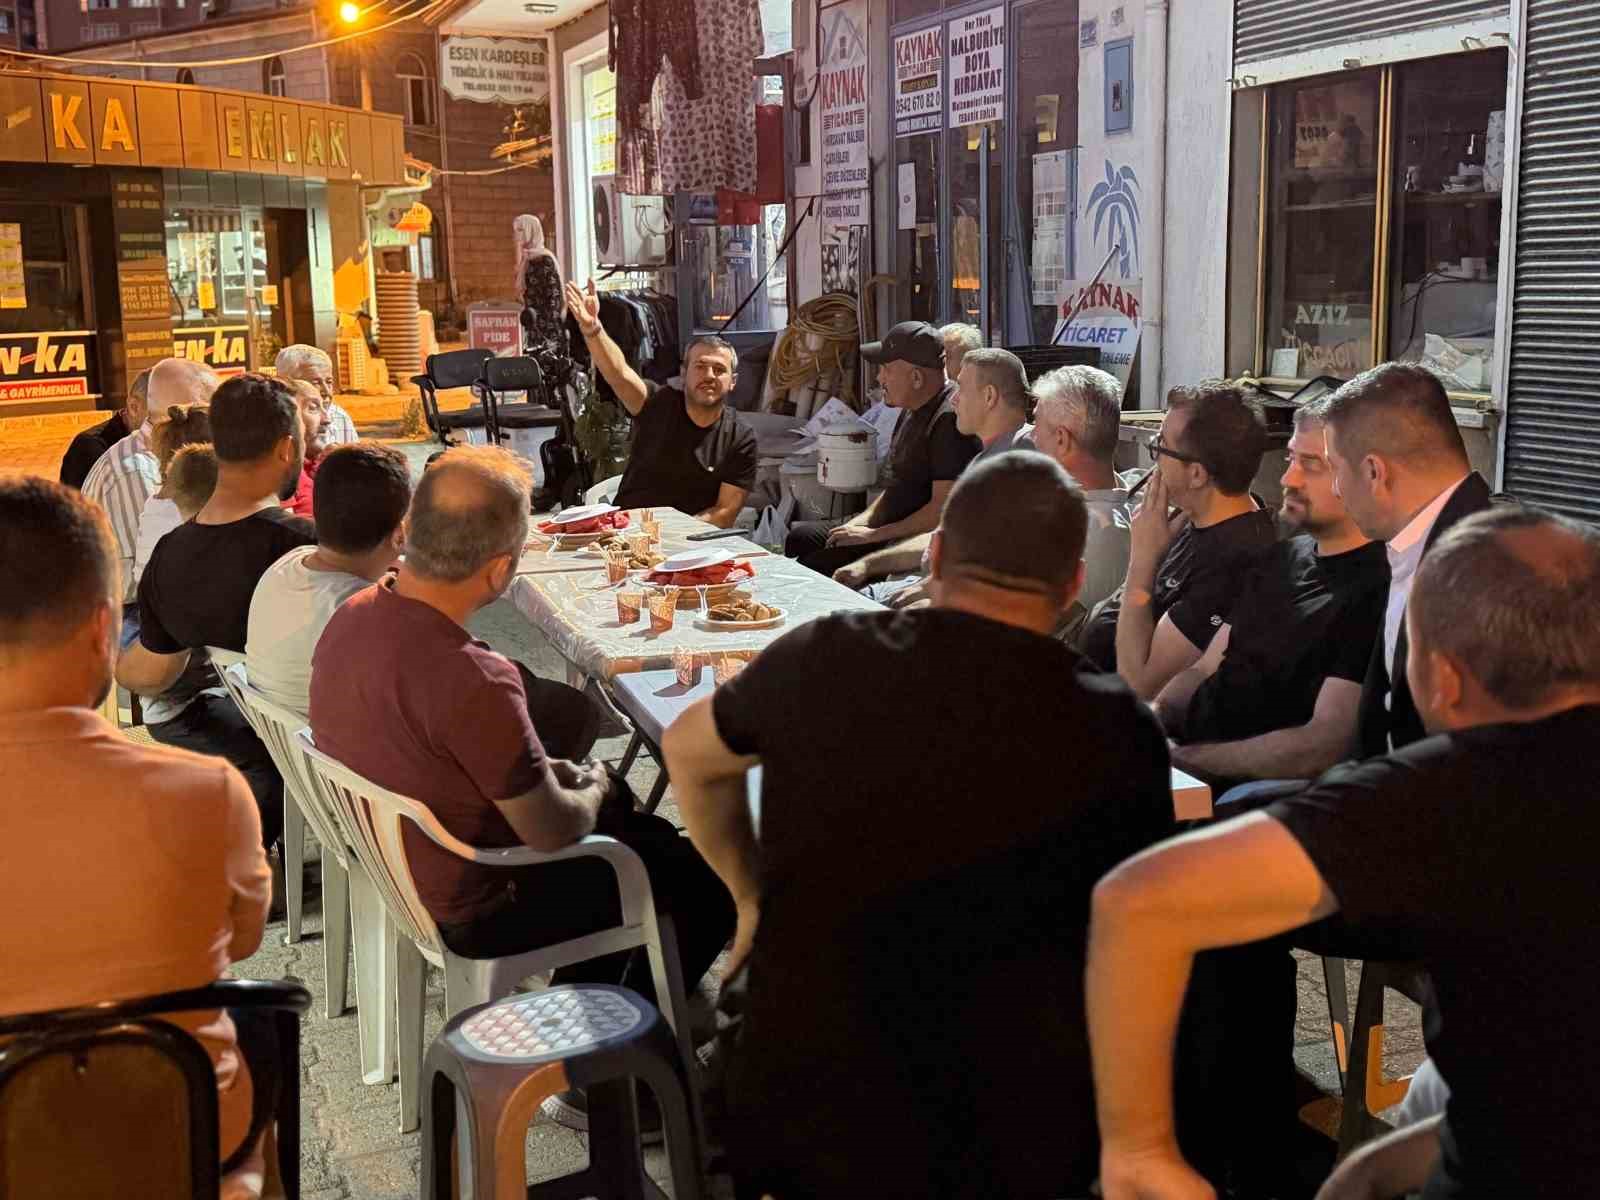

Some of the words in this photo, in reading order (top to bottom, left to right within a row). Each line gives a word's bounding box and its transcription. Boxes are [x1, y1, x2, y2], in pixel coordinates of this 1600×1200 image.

[449, 46, 478, 61] ESEN
[481, 48, 545, 67] KARDEŞLER
[896, 31, 941, 66] KAYNAK
[965, 51, 990, 73] BOYA
[823, 65, 865, 110] KAYNAK
[954, 69, 1002, 96] HIRDAVAT
[224, 106, 348, 167] EMLAK
[1063, 282, 1139, 320] KAYNAK
[173, 329, 246, 364] EN-KA
[1062, 323, 1127, 344] TİCARET
[9, 382, 82, 398] GAYRİMENKUL
